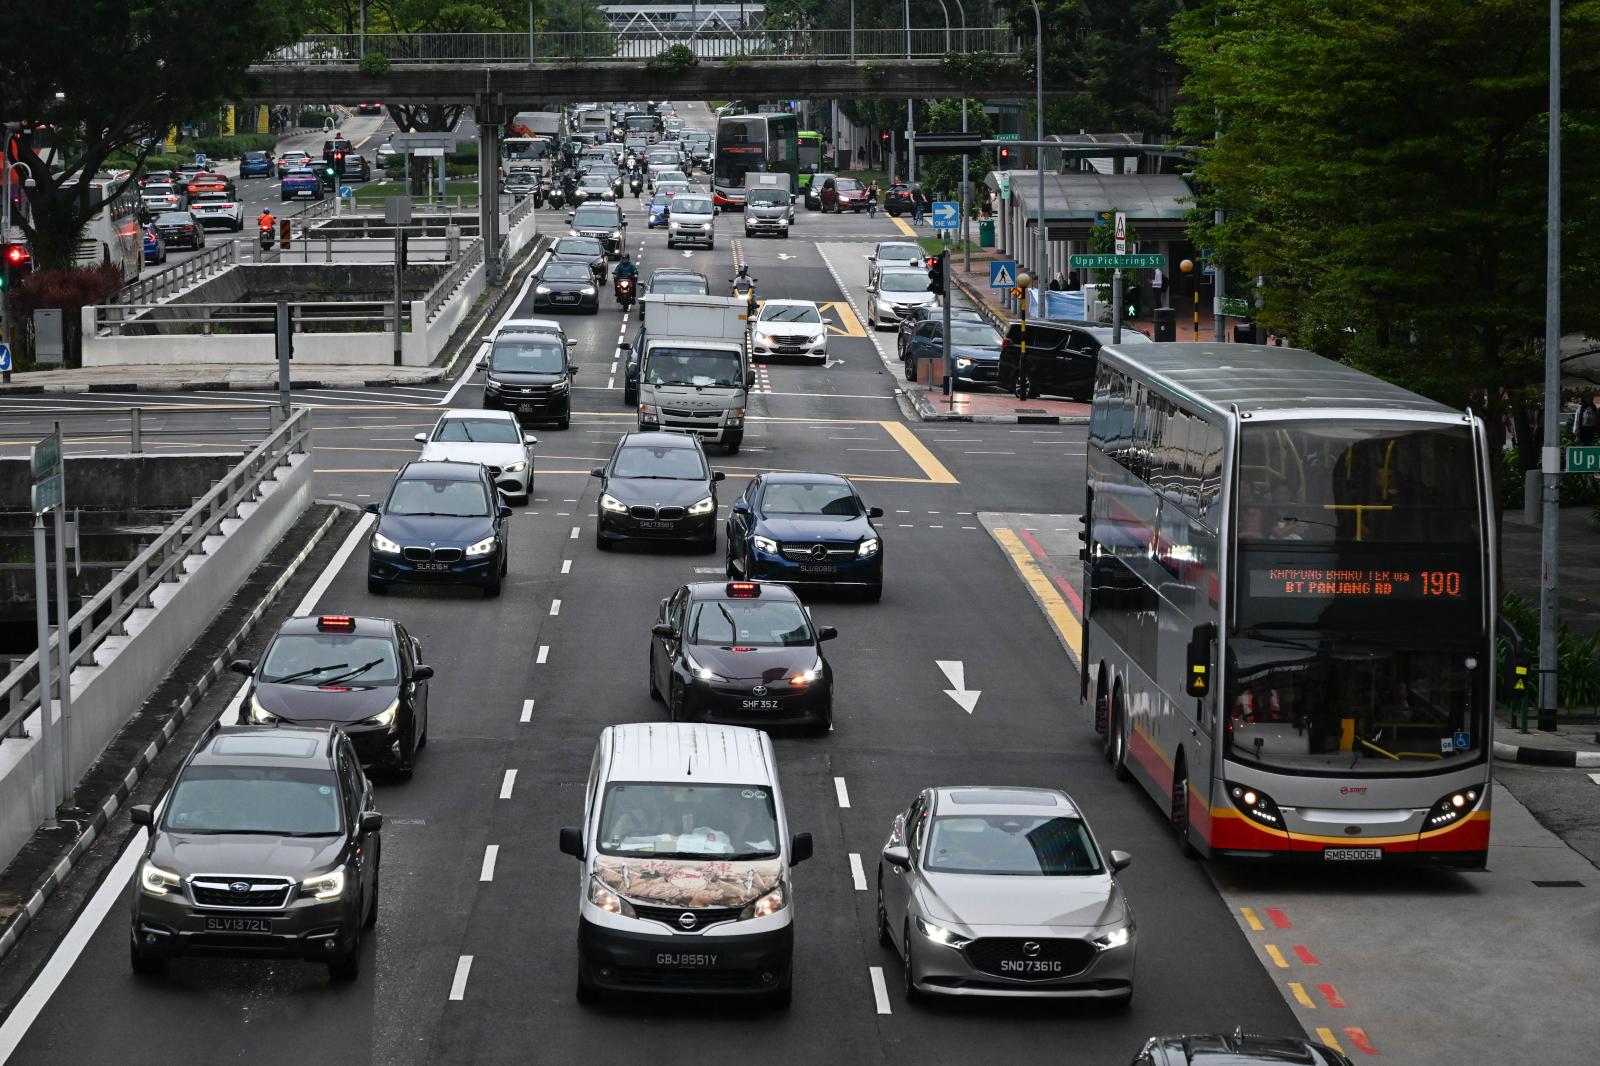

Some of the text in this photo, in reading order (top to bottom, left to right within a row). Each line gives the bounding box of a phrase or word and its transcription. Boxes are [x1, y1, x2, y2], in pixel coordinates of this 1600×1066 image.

[1076, 257, 1094, 266] Upp
[1149, 256, 1159, 265] St
[1573, 450, 1600, 469] Up
[1285, 582, 1392, 595] BT PANJANG RD
[1421, 571, 1460, 595] 190
[1325, 849, 1381, 860] SMB5006L
[207, 918, 268, 932] SLV1372L
[656, 953, 718, 965] GBJ8551Y
